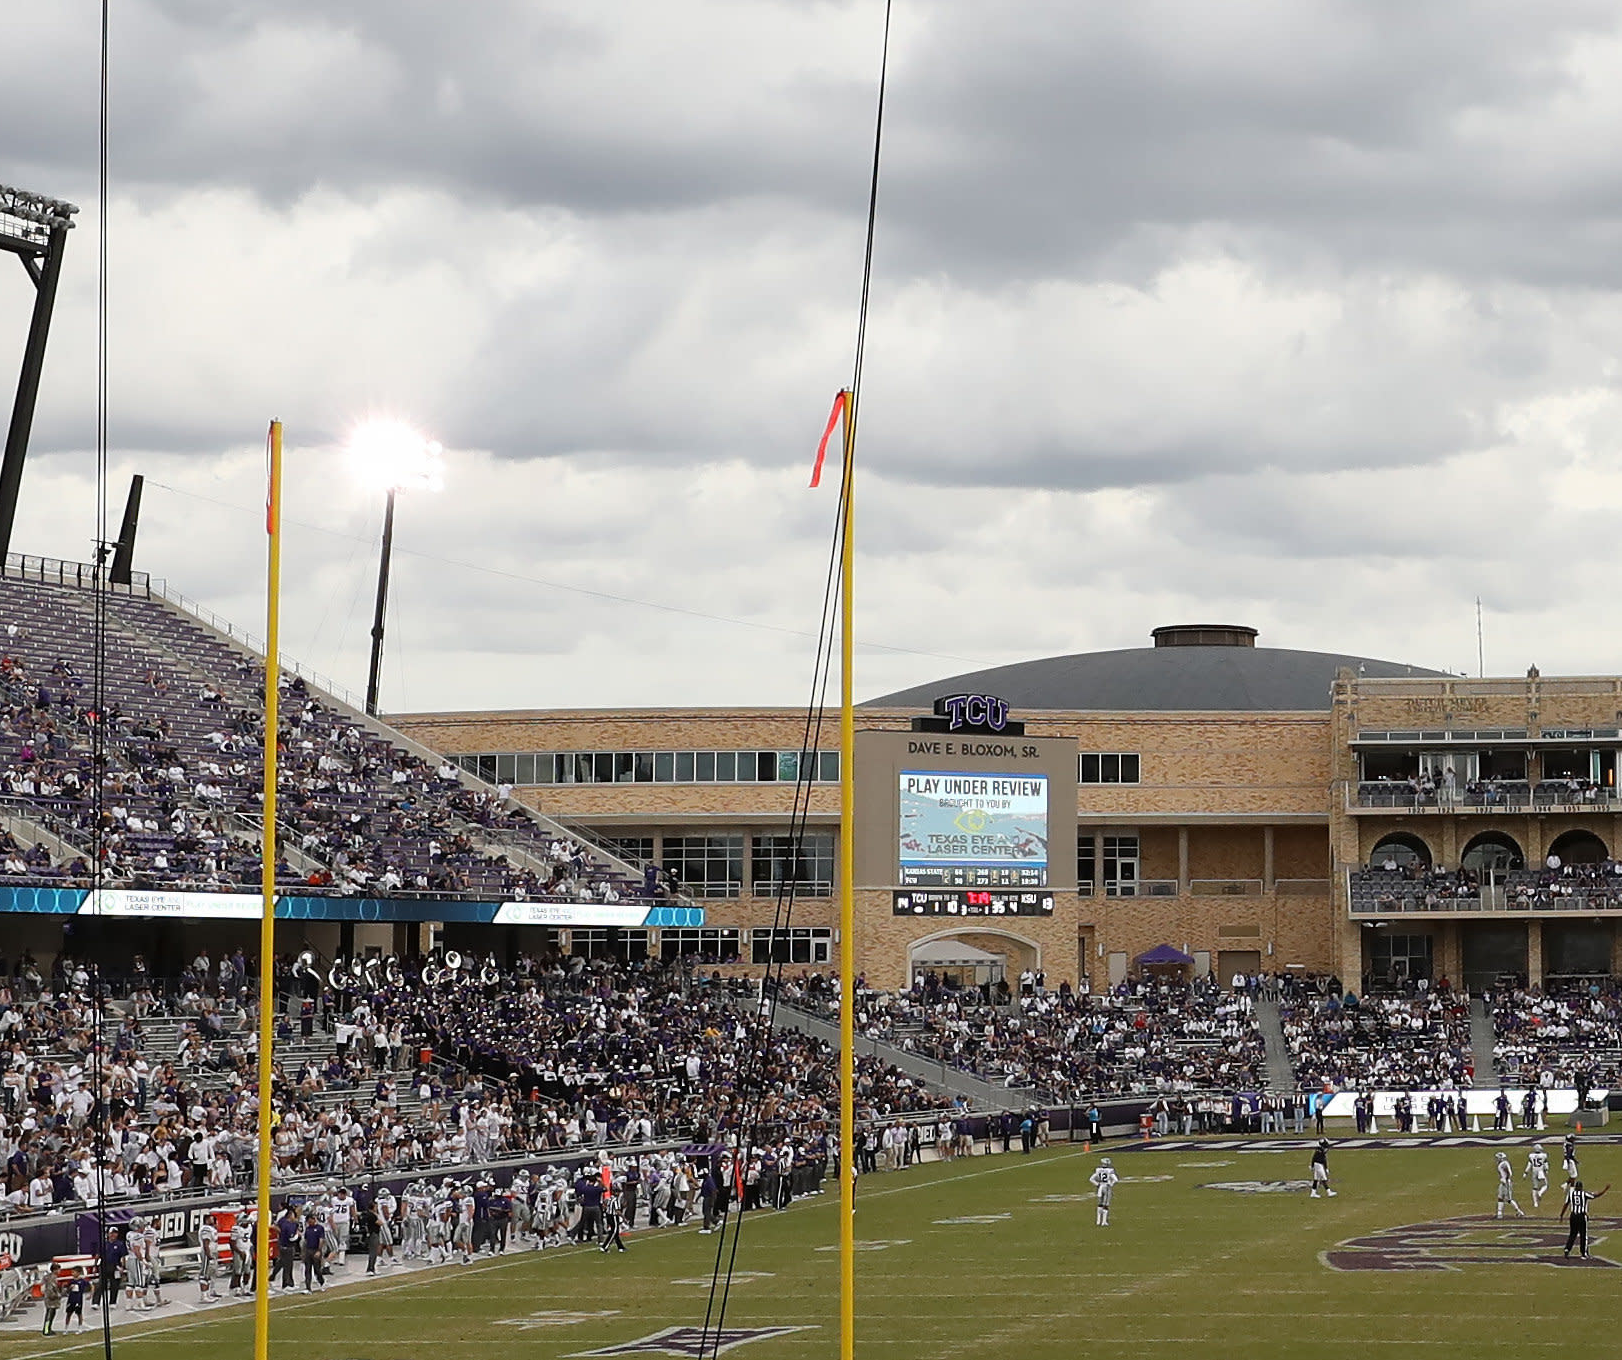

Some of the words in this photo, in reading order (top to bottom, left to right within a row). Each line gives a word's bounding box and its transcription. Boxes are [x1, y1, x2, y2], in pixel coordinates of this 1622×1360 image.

[945, 695, 1009, 732] TCU
[908, 741, 941, 754] DAVE
[945, 742, 956, 754] E.
[961, 743, 1017, 758] BLOXOM,
[1022, 746, 1040, 758] SR.
[908, 778, 939, 794] PLAY
[944, 780, 987, 795] UNDER
[992, 781, 1042, 797] REVIEW
[928, 834, 967, 844] TEXAS
[971, 834, 994, 844] EYE
[928, 844, 968, 854] LASER
[971, 845, 1022, 855] CENTER
[911, 893, 927, 904] TCU
